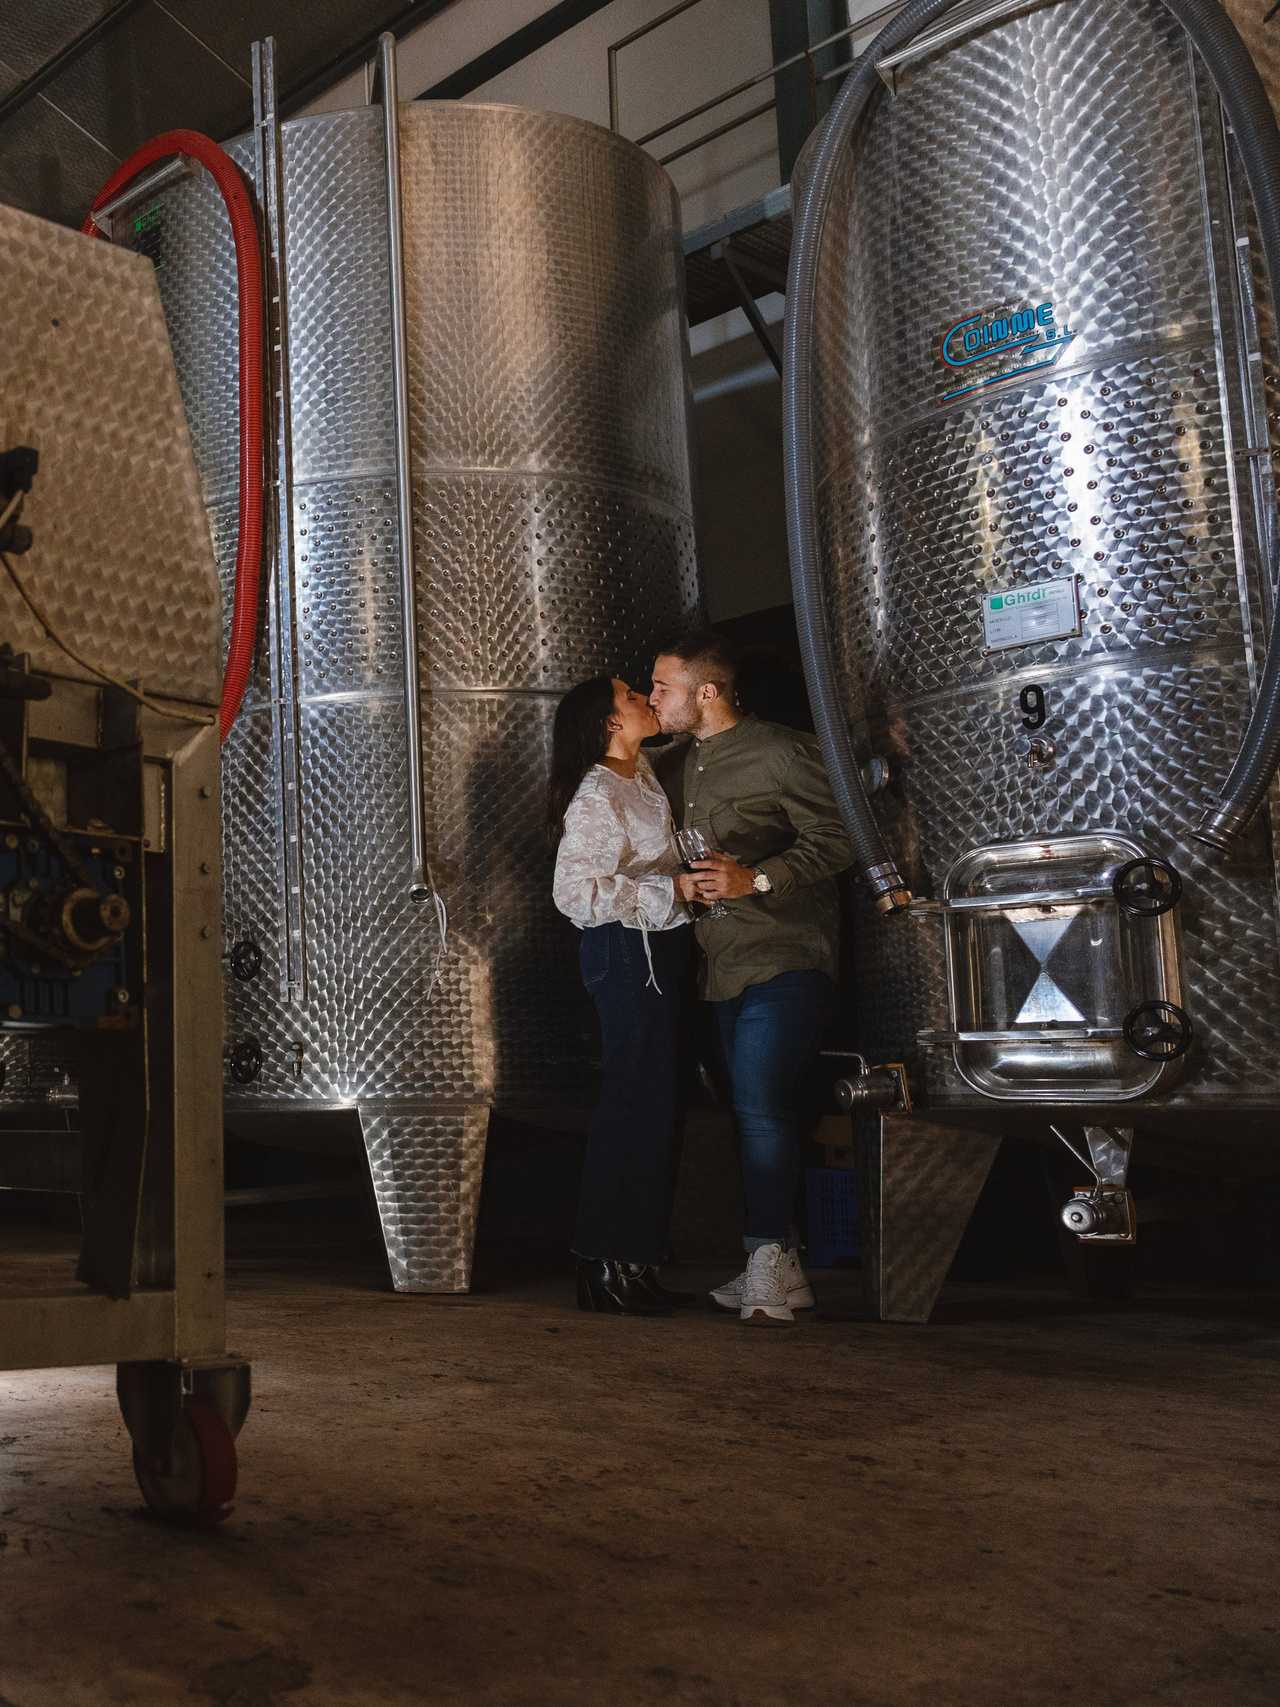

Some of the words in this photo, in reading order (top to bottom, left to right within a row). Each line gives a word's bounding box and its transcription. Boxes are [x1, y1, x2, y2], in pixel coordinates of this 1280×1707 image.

[940, 302, 1054, 369] COINME
[1004, 588, 1046, 606] Ghidi
[989, 616, 1012, 624] MODELLO
[991, 635, 1018, 644] MATRICOLA
[1020, 684, 1046, 730] 9
